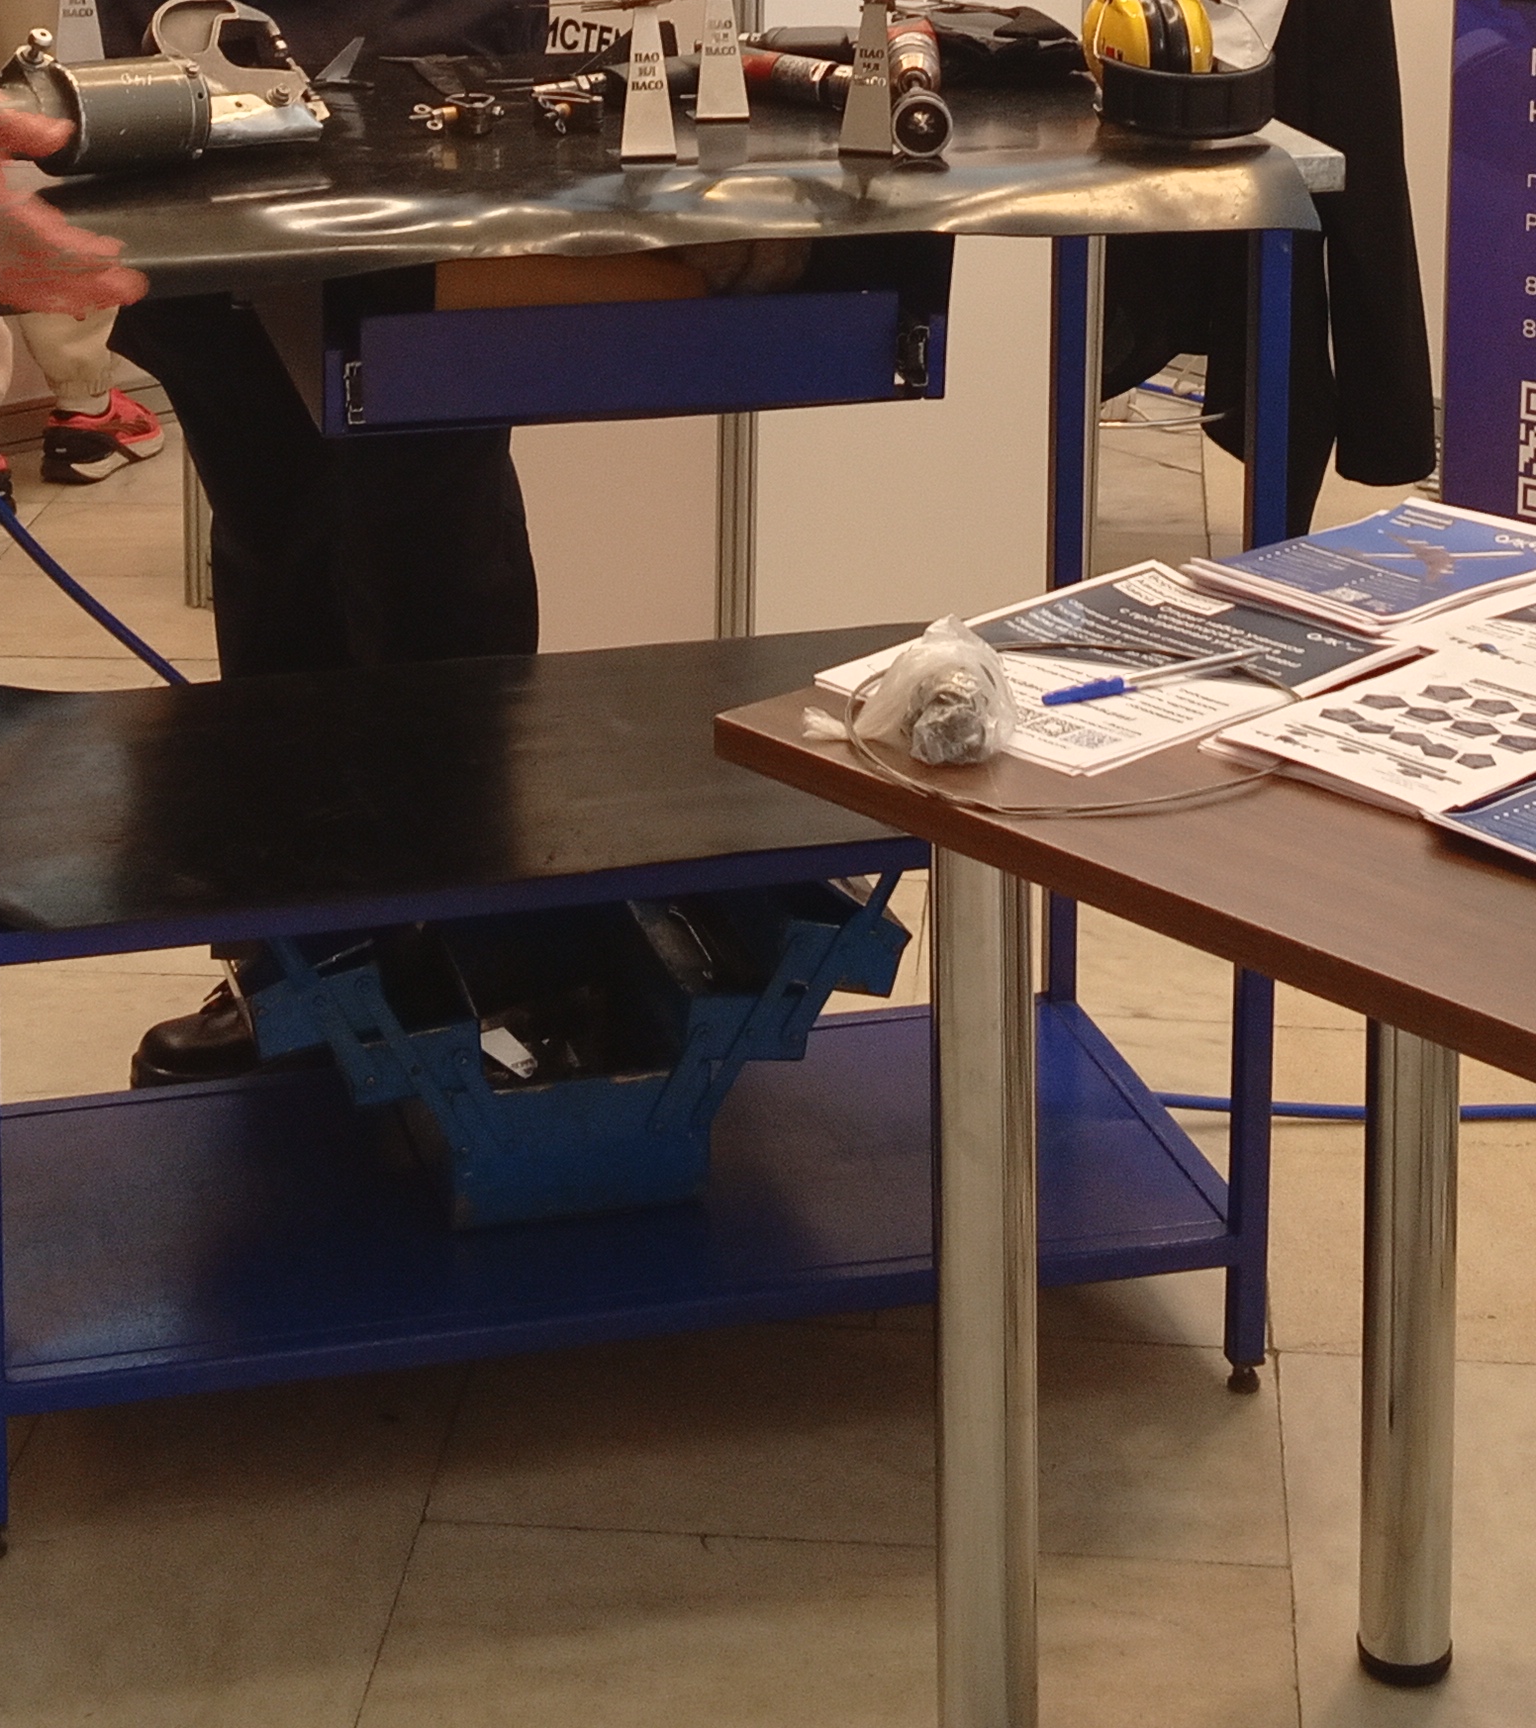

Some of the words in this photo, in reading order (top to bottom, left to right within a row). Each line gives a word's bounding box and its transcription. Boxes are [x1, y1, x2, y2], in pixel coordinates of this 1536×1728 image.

[634, 52, 660, 63] ПАО
[631, 80, 664, 91] ВАСО
[1522, 319, 1536, 339] 8
